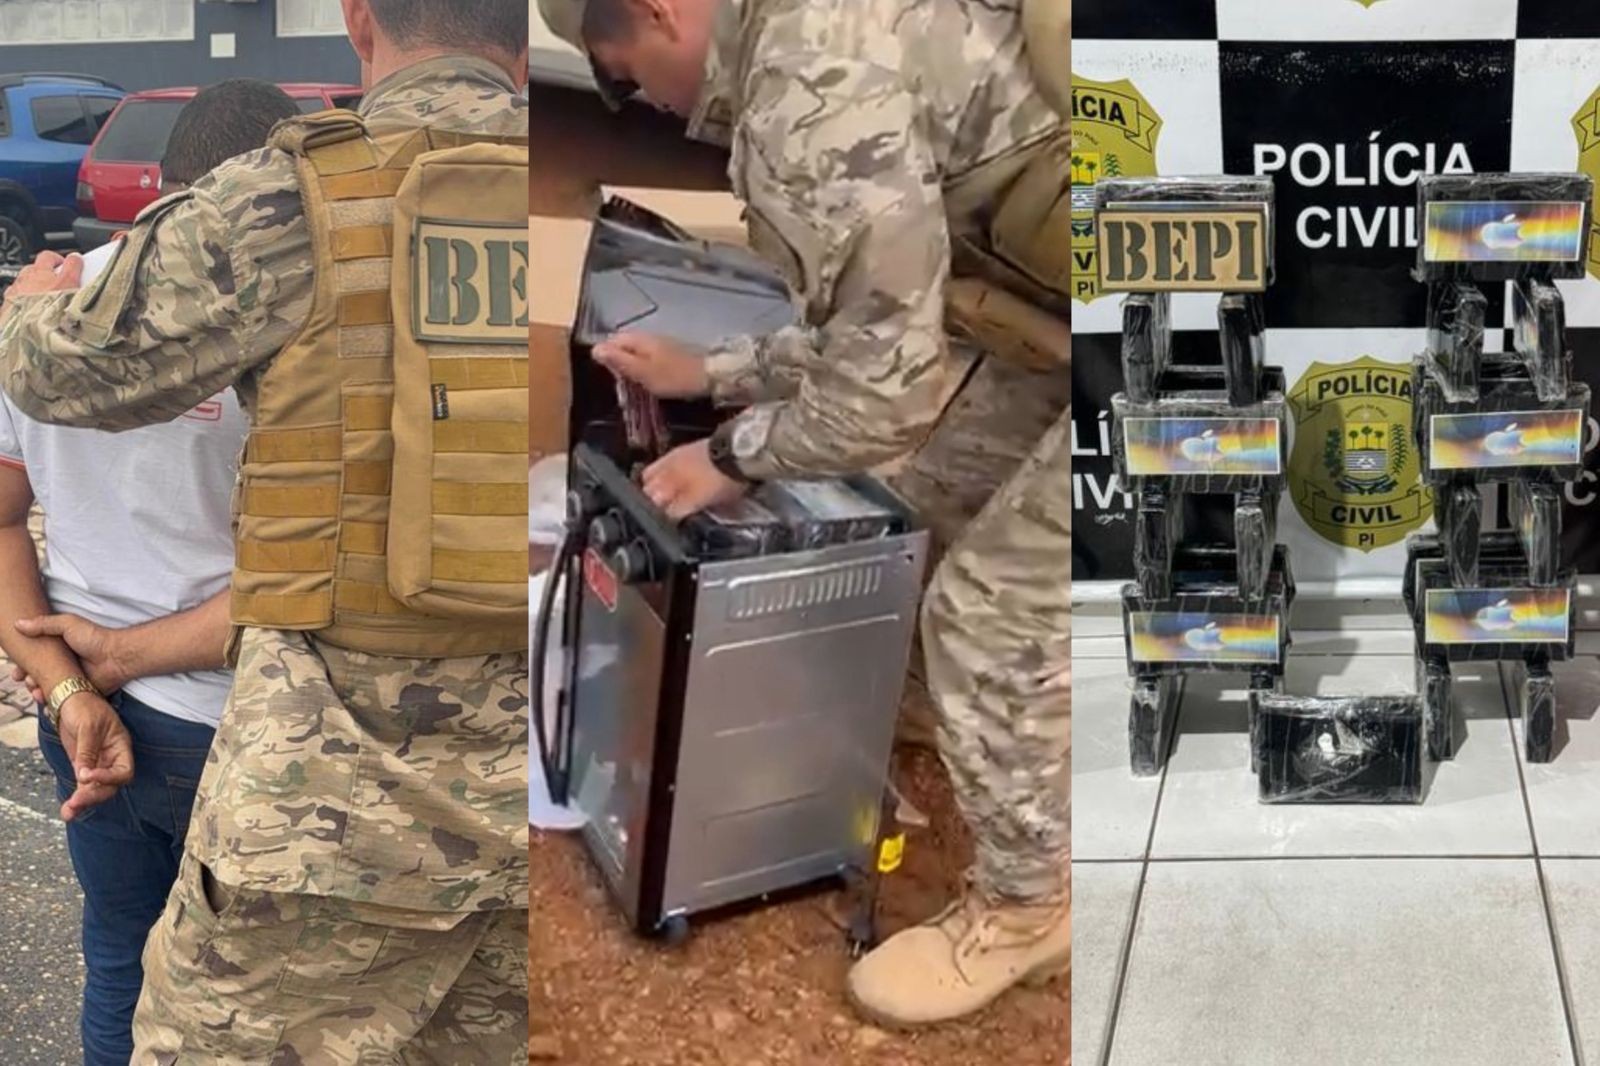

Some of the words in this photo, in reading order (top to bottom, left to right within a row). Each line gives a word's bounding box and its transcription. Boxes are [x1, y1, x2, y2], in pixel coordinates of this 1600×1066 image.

[1253, 131, 1475, 188] POLÍCIA
[1295, 206, 1419, 249] CIVIL
[1103, 220, 1259, 281] BEPI
[423, 236, 529, 327] BE
[1077, 281, 1095, 296] PI
[1317, 369, 1413, 400] POLÍCIA
[1331, 504, 1402, 524] CIVIL
[1358, 532, 1375, 547] PI
